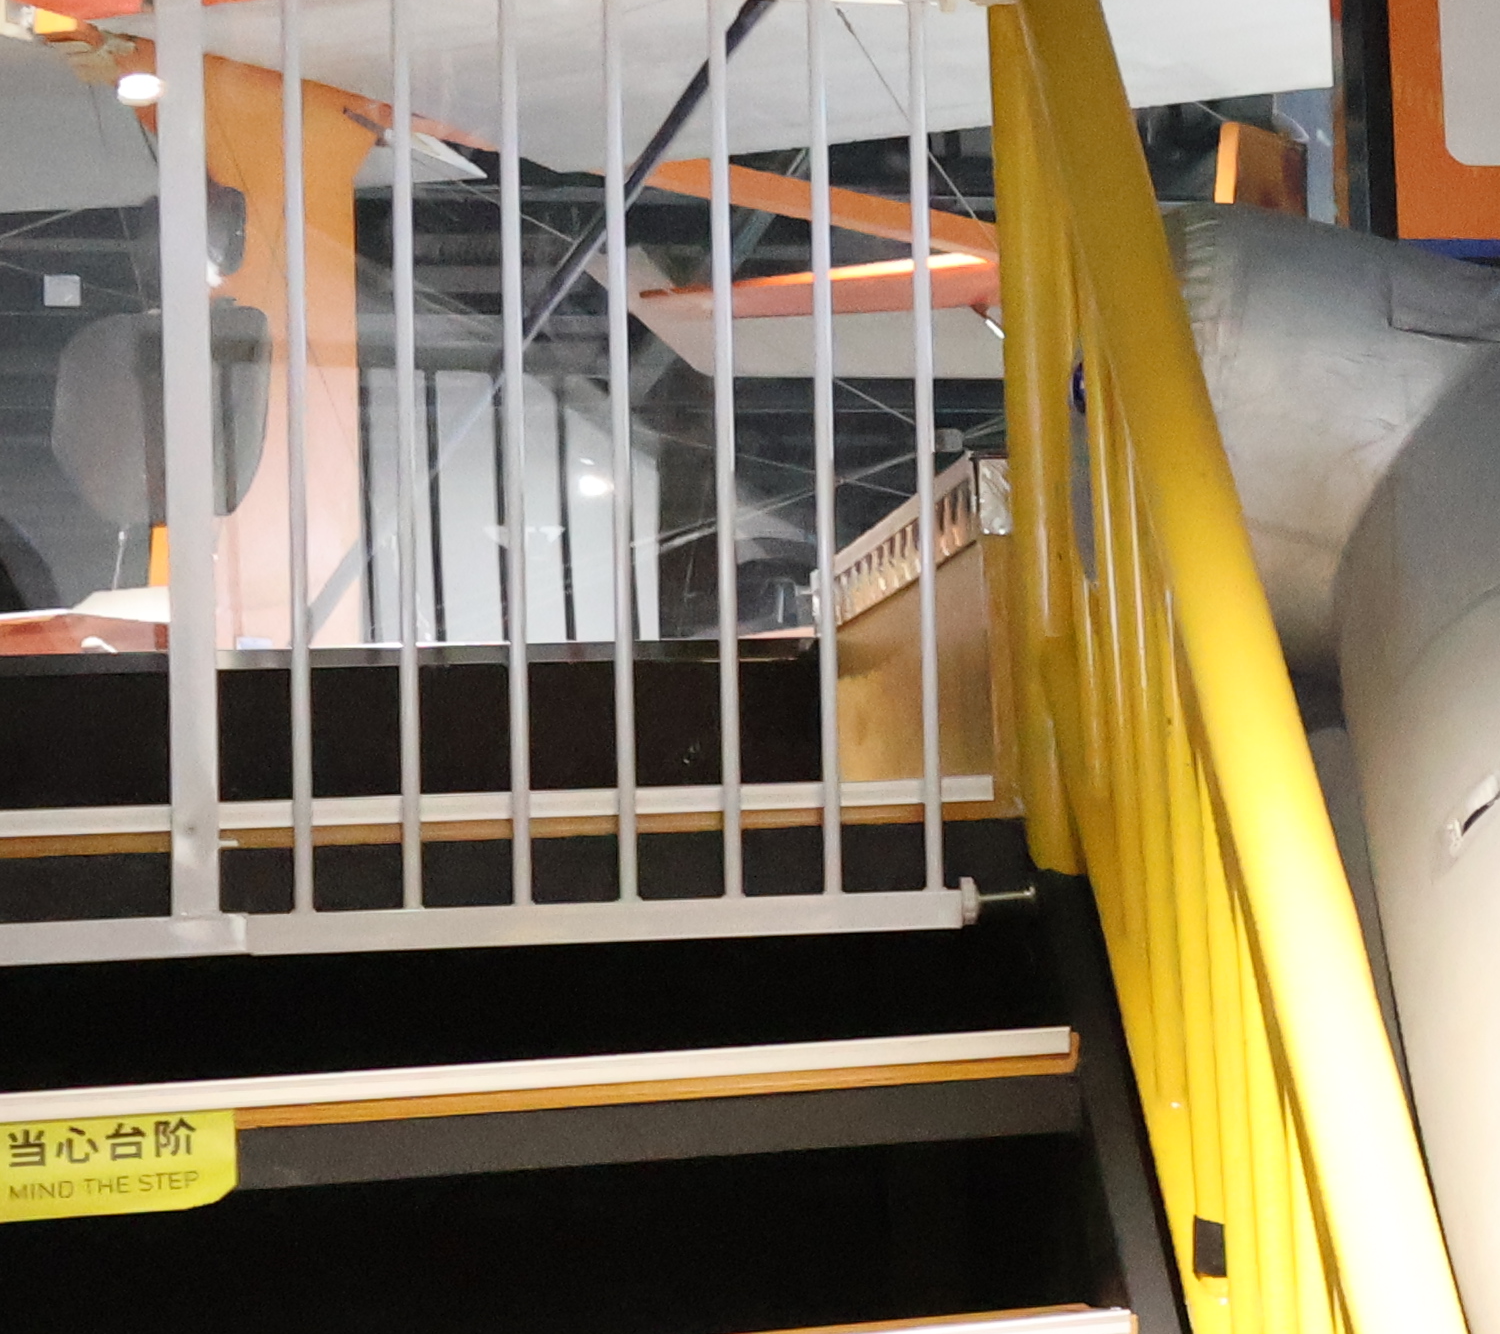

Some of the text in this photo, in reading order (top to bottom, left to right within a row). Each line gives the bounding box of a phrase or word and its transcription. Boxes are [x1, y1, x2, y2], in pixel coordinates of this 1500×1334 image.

[8, 1118, 197, 1167] 当心台阶
[9, 1171, 200, 1200] MIND THE STEP
